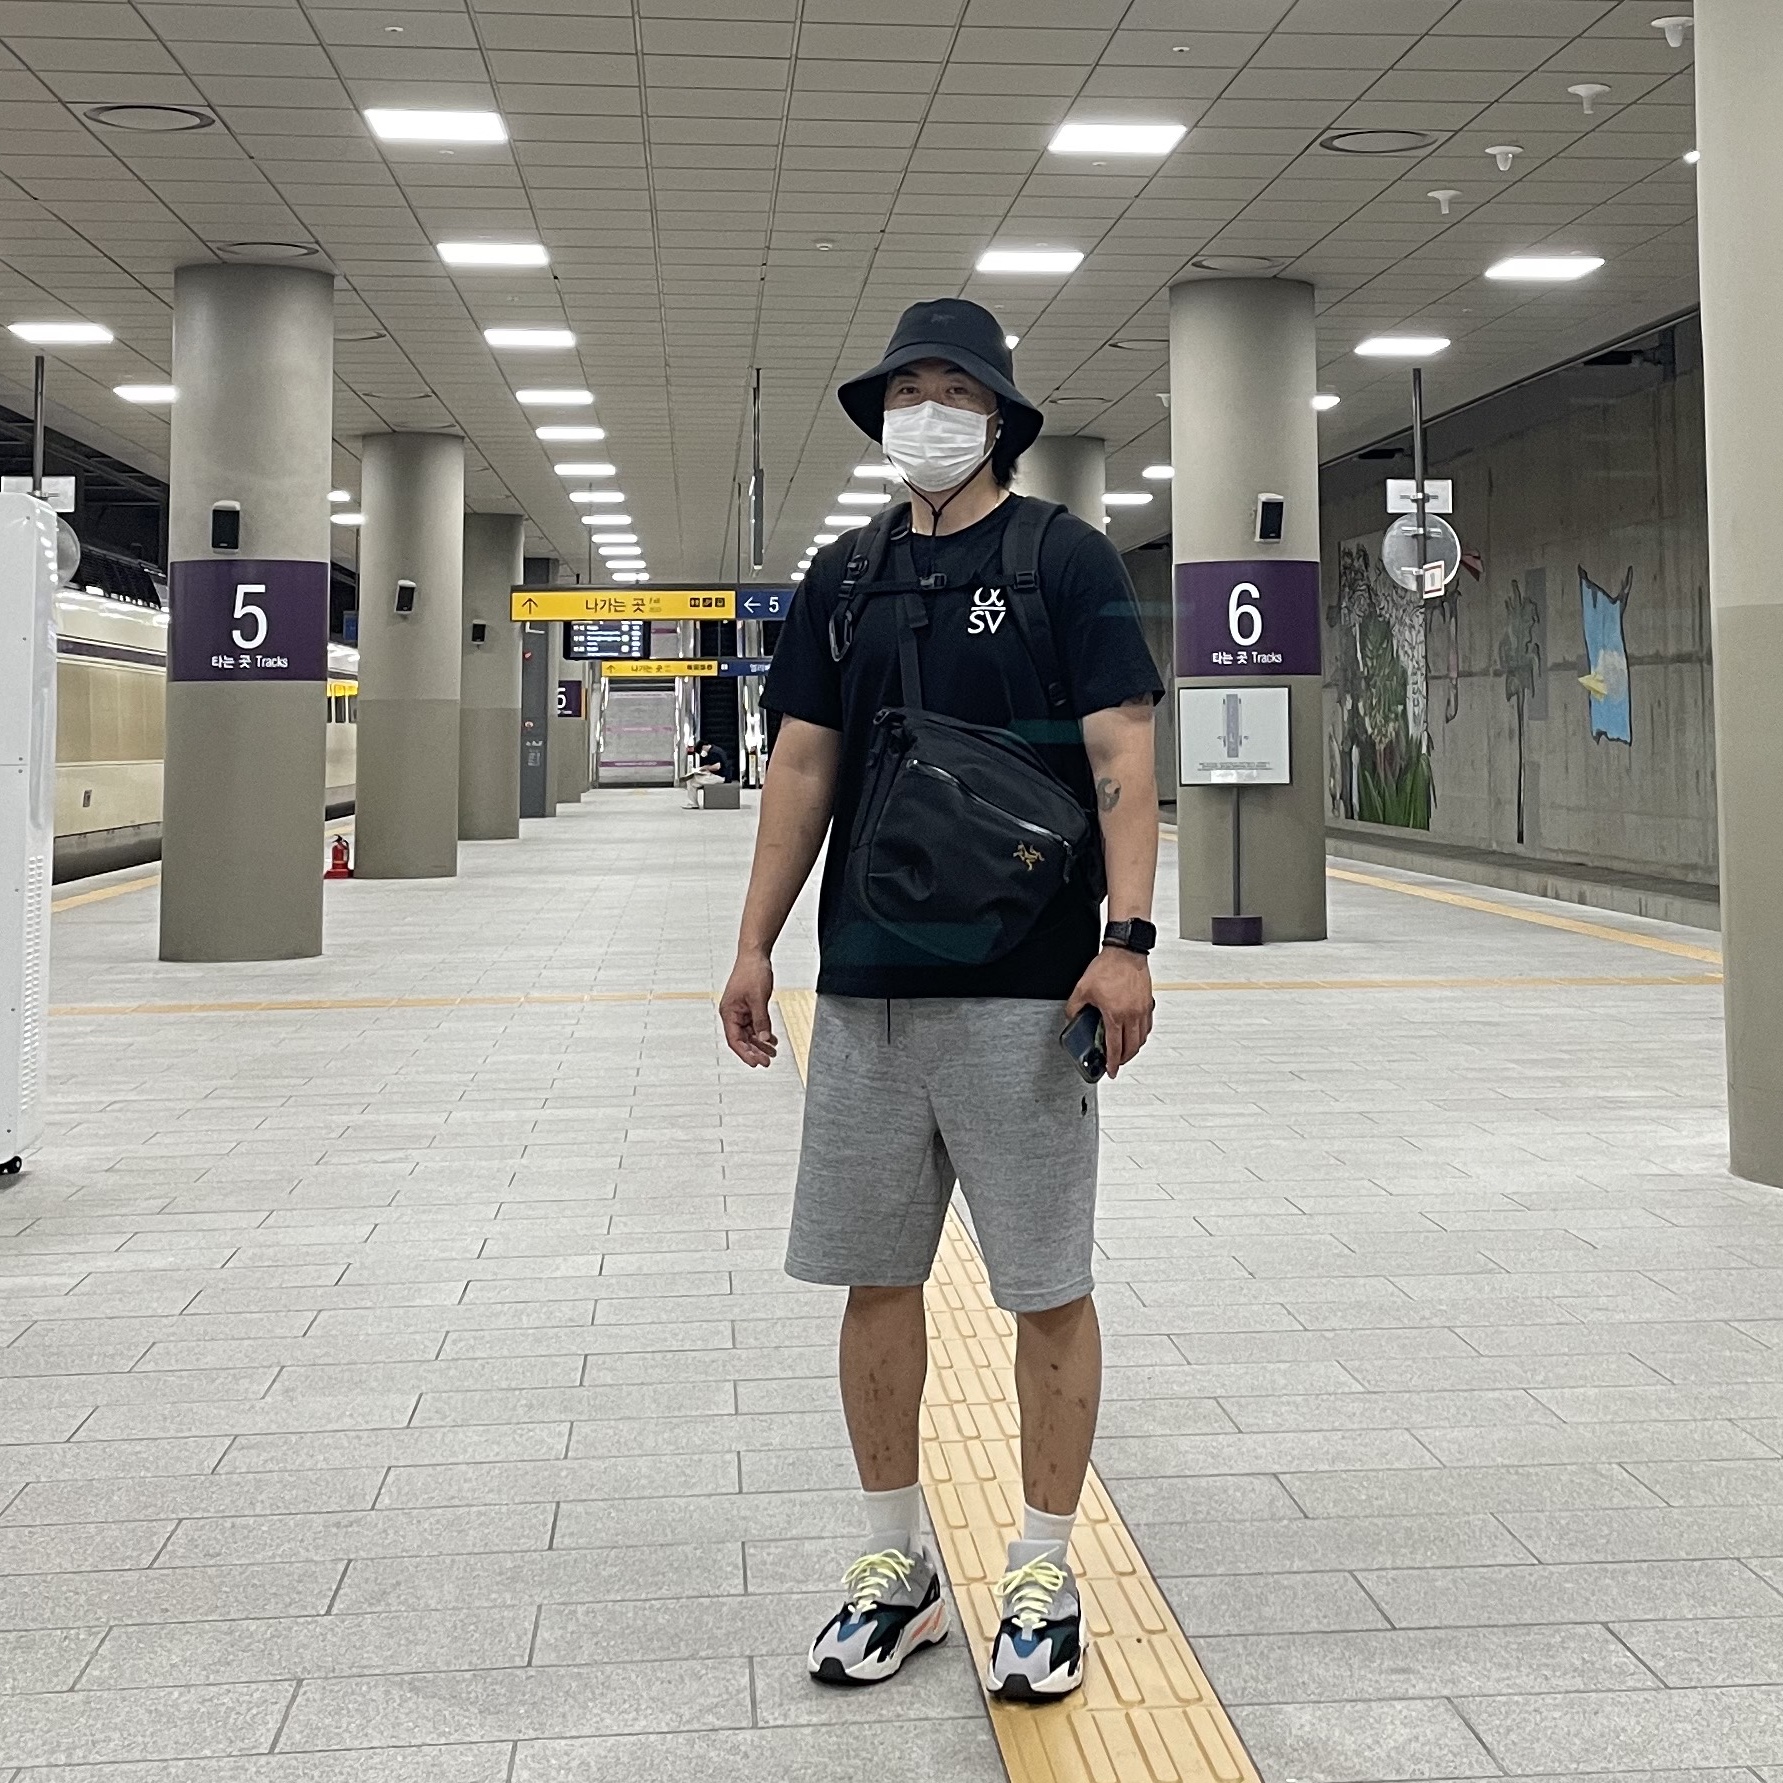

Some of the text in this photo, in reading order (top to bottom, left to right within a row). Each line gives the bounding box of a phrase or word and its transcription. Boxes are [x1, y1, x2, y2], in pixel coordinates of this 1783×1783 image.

[585, 597, 627, 613] 나가는
[631, 597, 646, 613] 곳
[768, 596, 780, 613] 5
[232, 584, 267, 649] 5
[967, 610, 1006, 634] SV
[1228, 582, 1262, 646] 6
[211, 654, 288, 668] 타는 곳 Tracks
[1212, 651, 1282, 664] 타는 곳 Tracks
